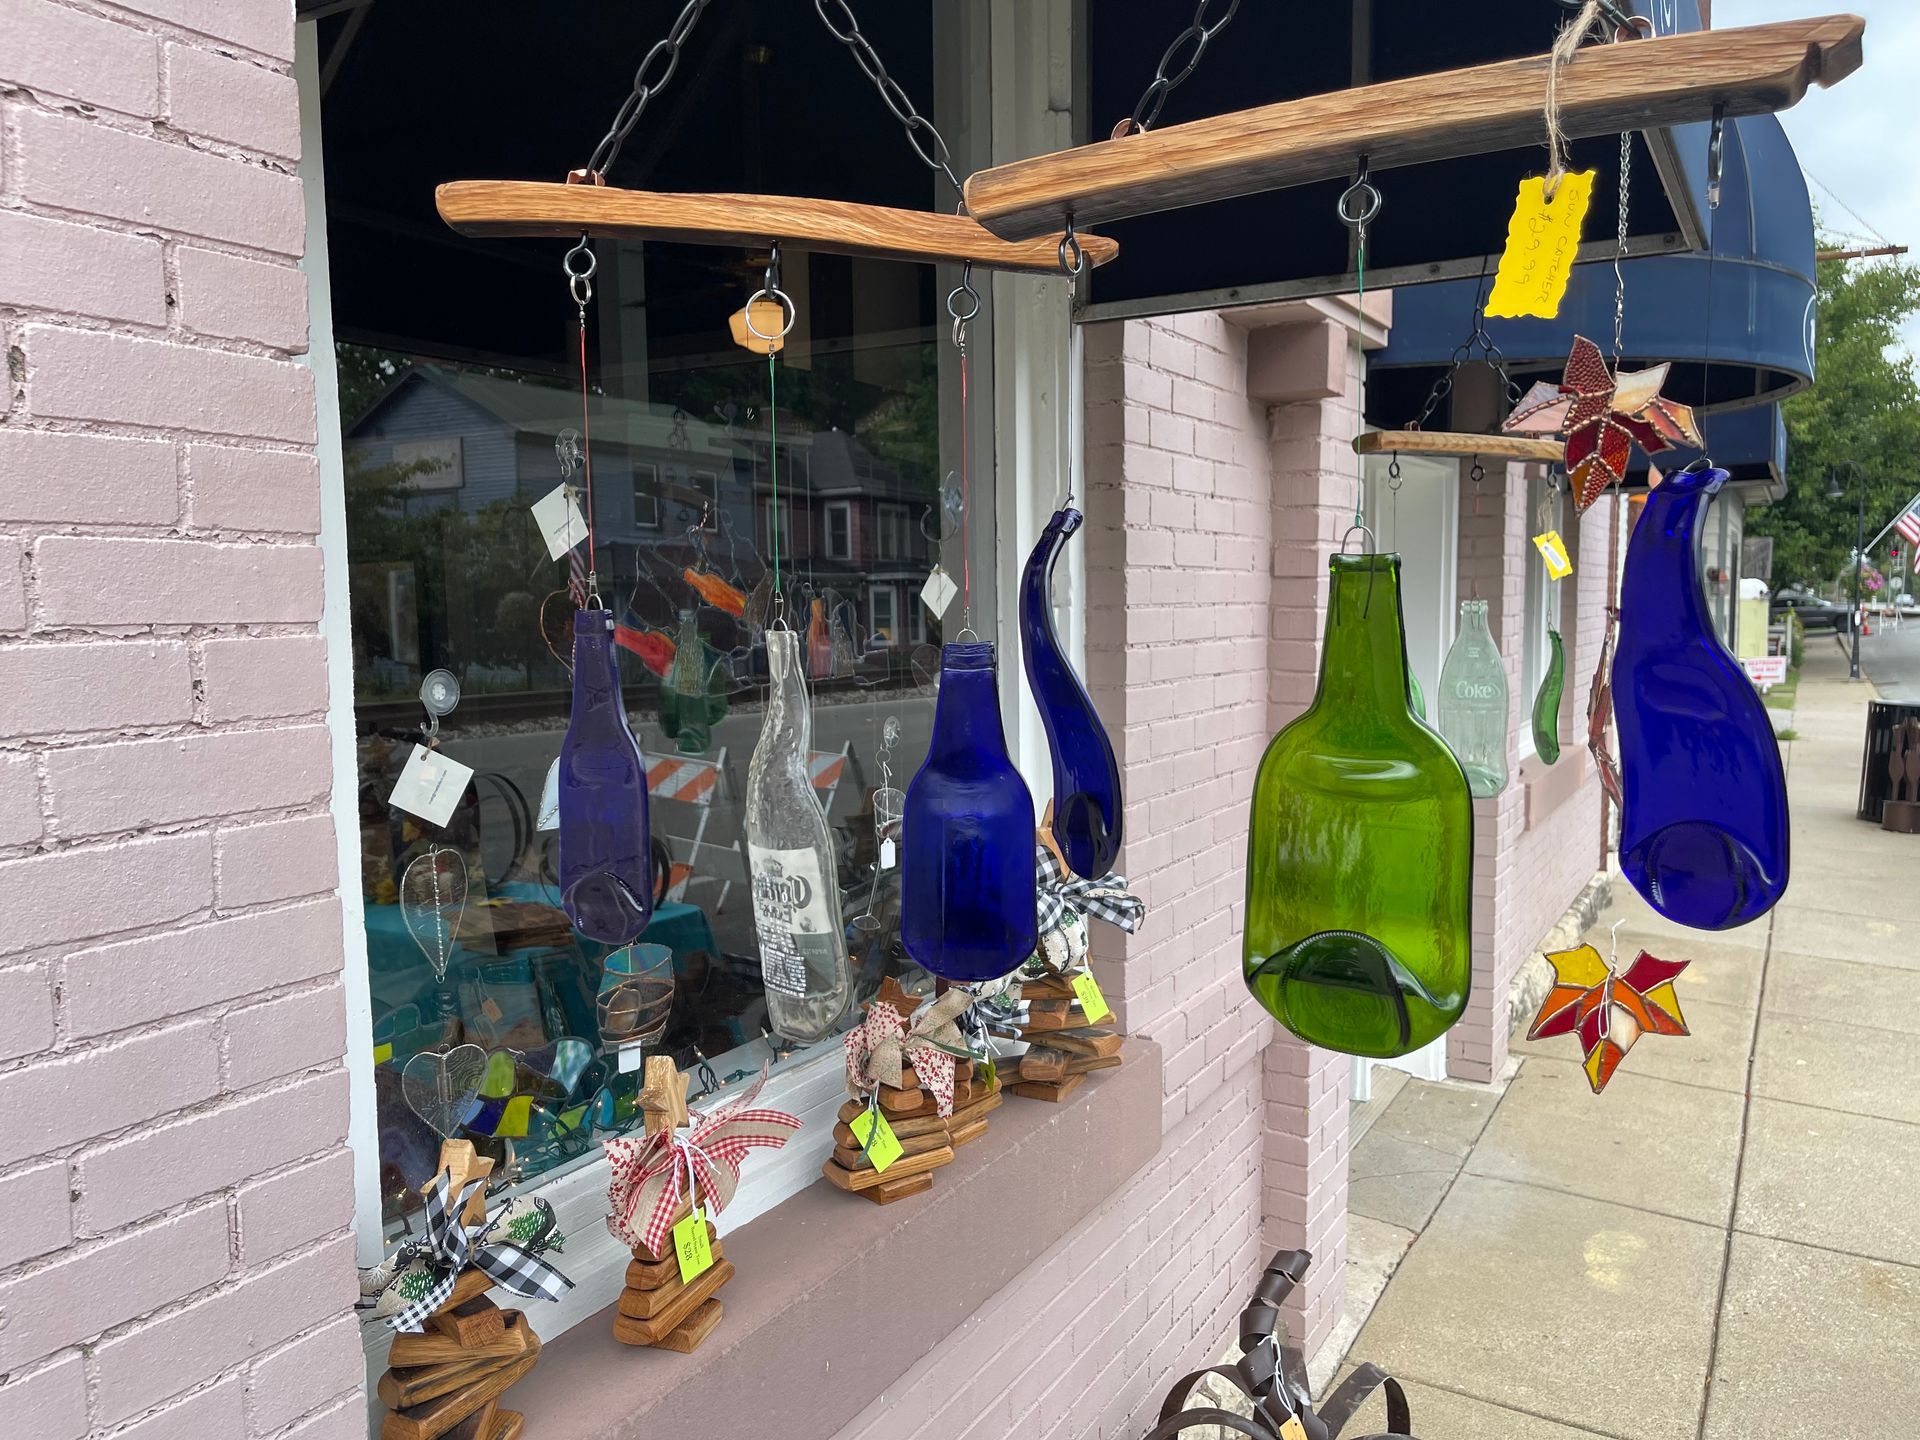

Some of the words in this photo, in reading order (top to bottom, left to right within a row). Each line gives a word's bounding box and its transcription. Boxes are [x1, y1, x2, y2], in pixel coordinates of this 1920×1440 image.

[1564, 189, 1580, 228] SUN
[1535, 236, 1568, 303] CATCHER
[1455, 680, 1492, 698] Coke
[683, 1241, 693, 1261] $28
